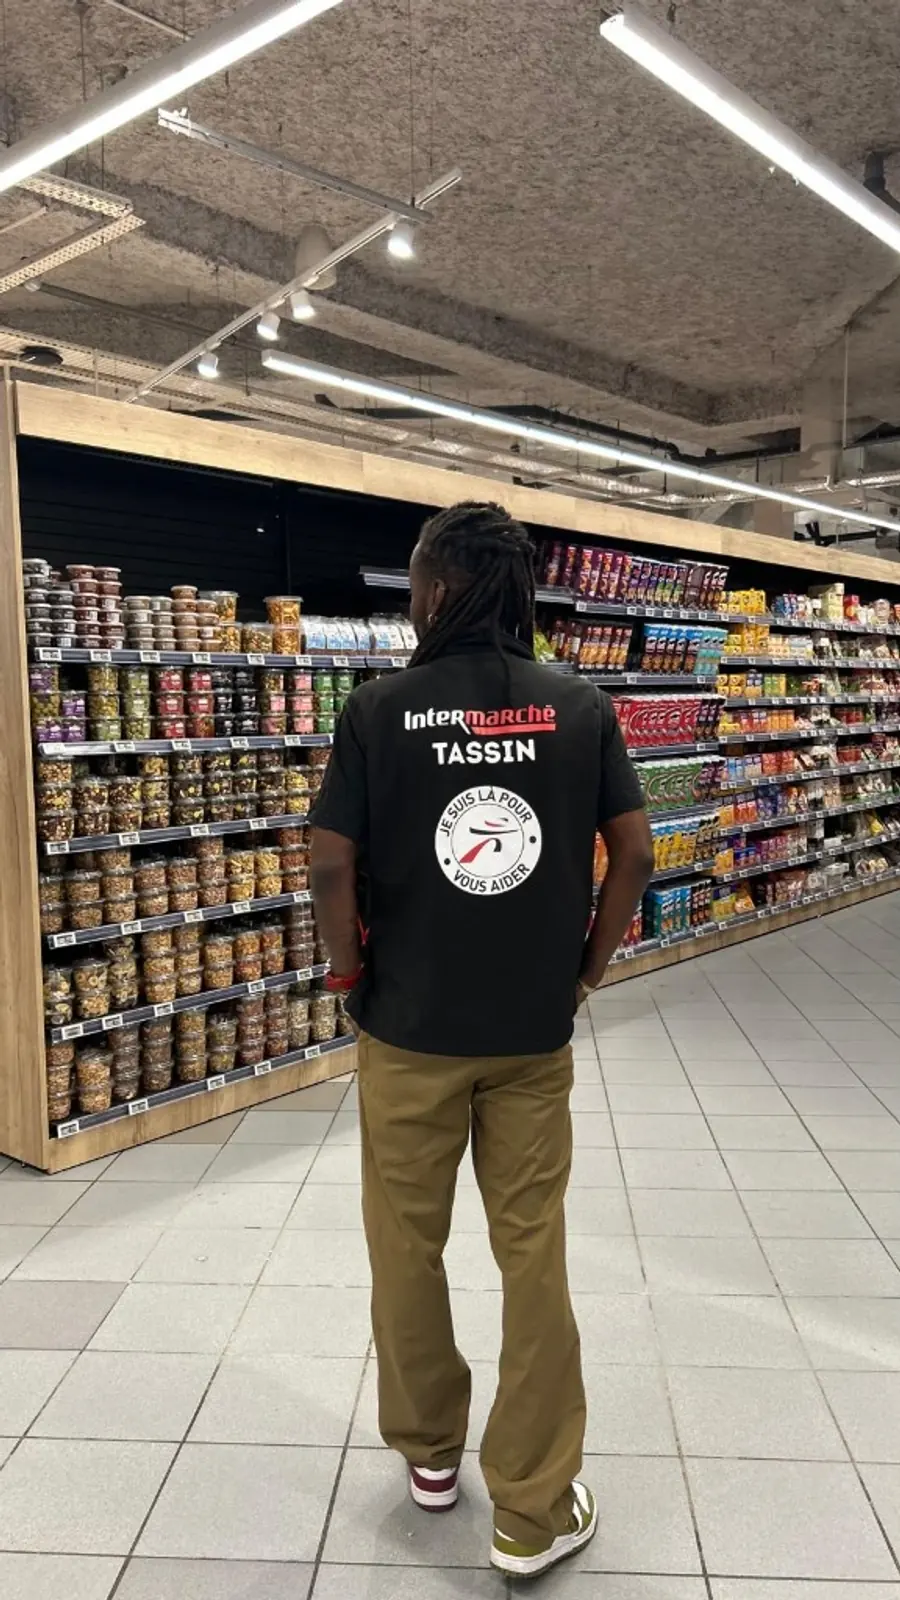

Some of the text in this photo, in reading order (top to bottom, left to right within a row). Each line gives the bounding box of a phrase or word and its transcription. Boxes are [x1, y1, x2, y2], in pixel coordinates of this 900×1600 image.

[432, 739, 536, 765] TASSIN
[440, 786, 533, 837] JE SUIS LÀ POUR
[453, 863, 531, 893] VOUS AIDER
